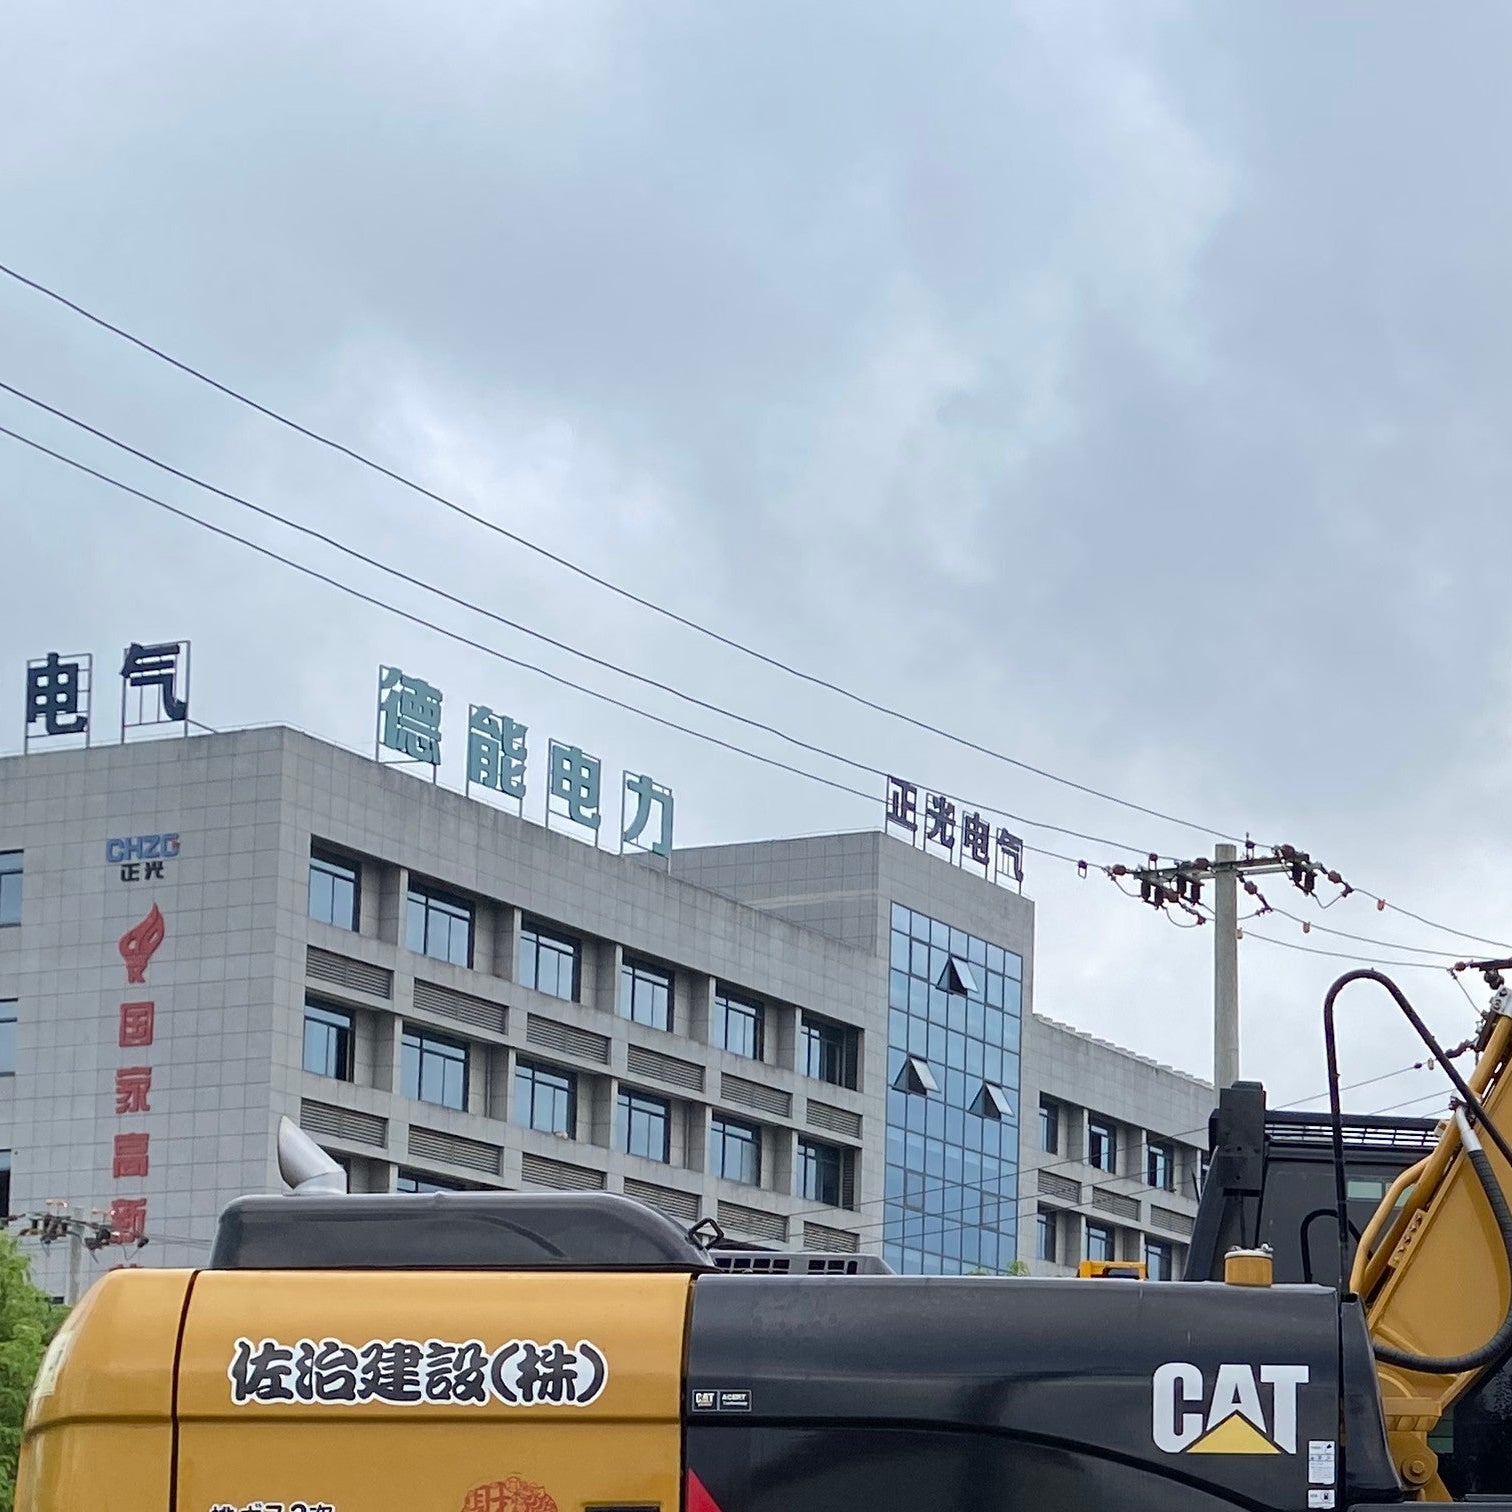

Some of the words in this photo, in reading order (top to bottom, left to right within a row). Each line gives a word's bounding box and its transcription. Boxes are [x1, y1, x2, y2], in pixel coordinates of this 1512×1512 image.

[25, 642, 186, 735] 电气
[379, 666, 673, 857] 德能电力
[106, 833, 180, 863] CHZG
[121, 861, 164, 882] 正光
[887, 777, 1023, 882] 正光电气
[109, 1001, 154, 1269] 国家高新
[1152, 1362, 1309, 1454] CAT
